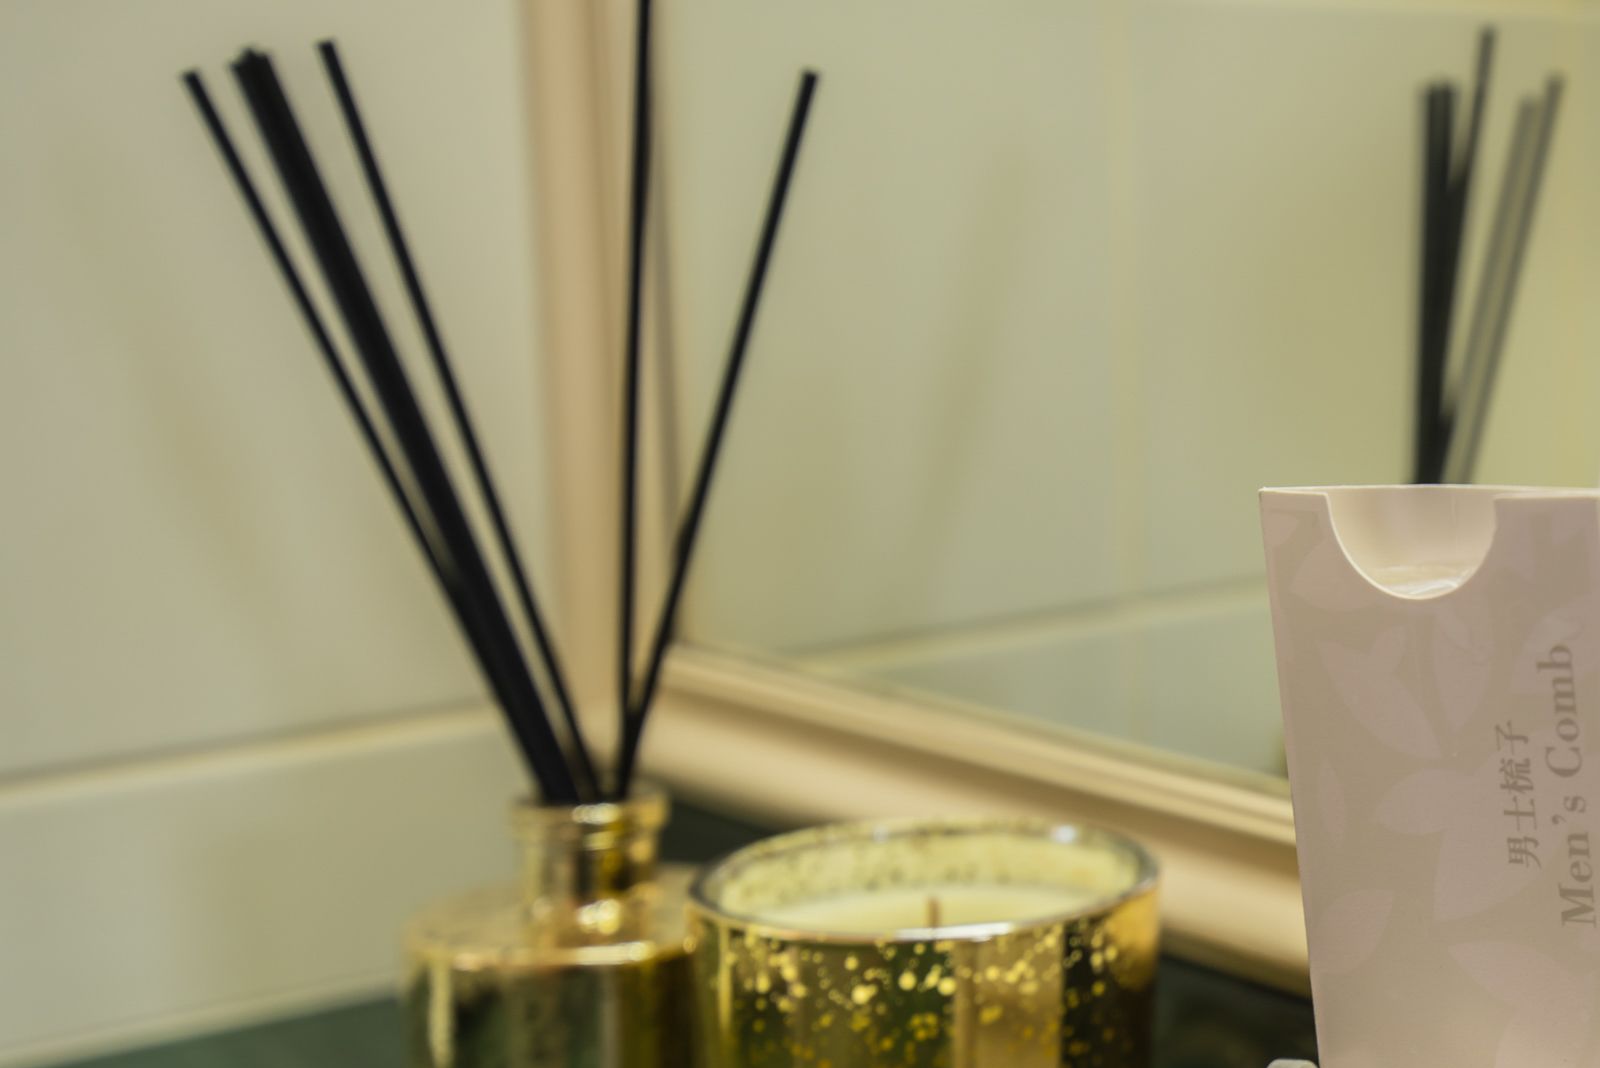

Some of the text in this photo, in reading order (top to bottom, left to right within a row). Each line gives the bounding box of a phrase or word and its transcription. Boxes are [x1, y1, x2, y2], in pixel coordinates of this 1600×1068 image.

[1536, 644, 1583, 778] Comb
[1494, 719, 1542, 870] 男士梳子
